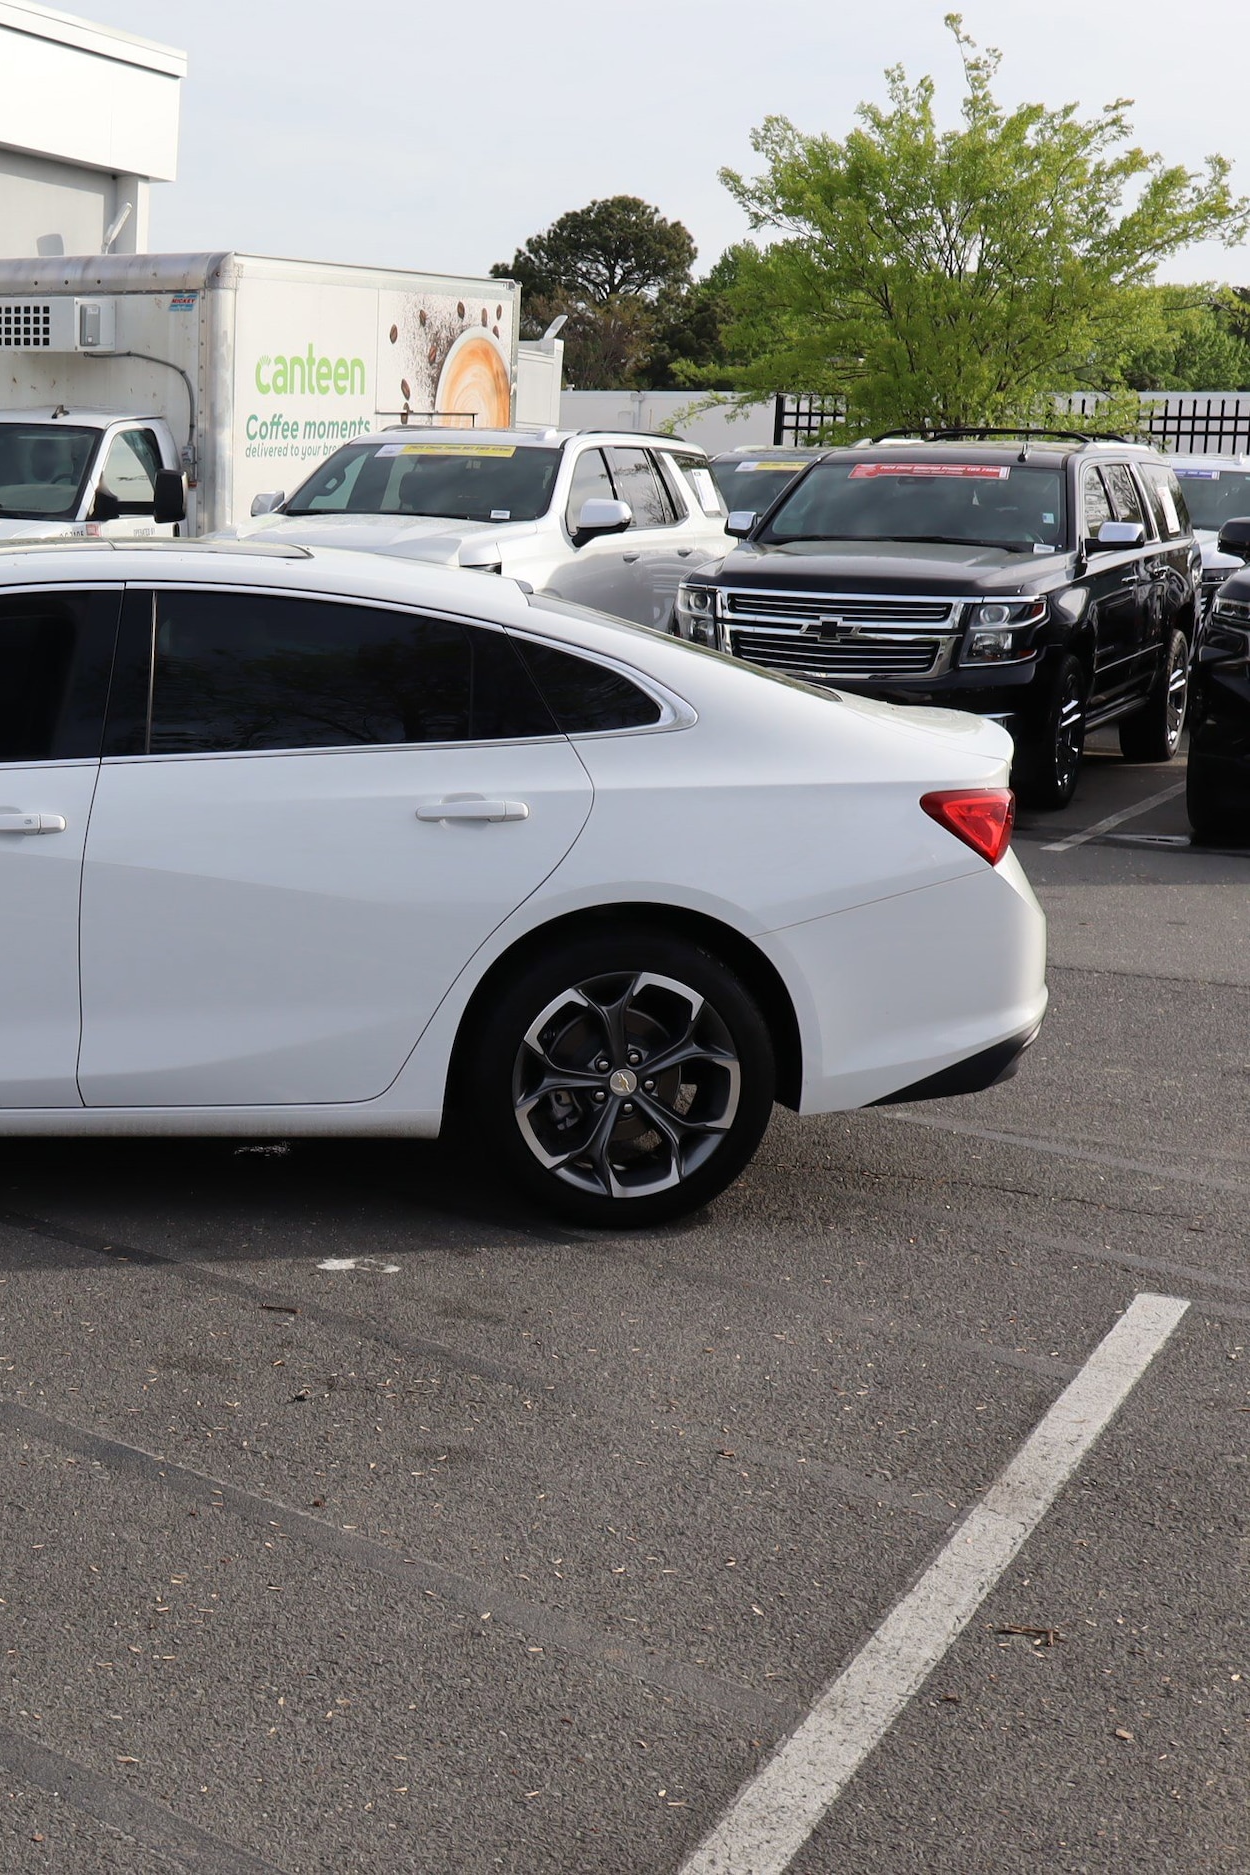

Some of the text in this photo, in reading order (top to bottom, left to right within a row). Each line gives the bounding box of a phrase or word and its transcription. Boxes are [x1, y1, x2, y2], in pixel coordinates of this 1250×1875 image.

[255, 343, 366, 396] canteen
[246, 413, 371, 441] Coffee moments
[245, 443, 289, 458] delivered
[290, 443, 300, 457] to
[301, 445, 321, 461] your
